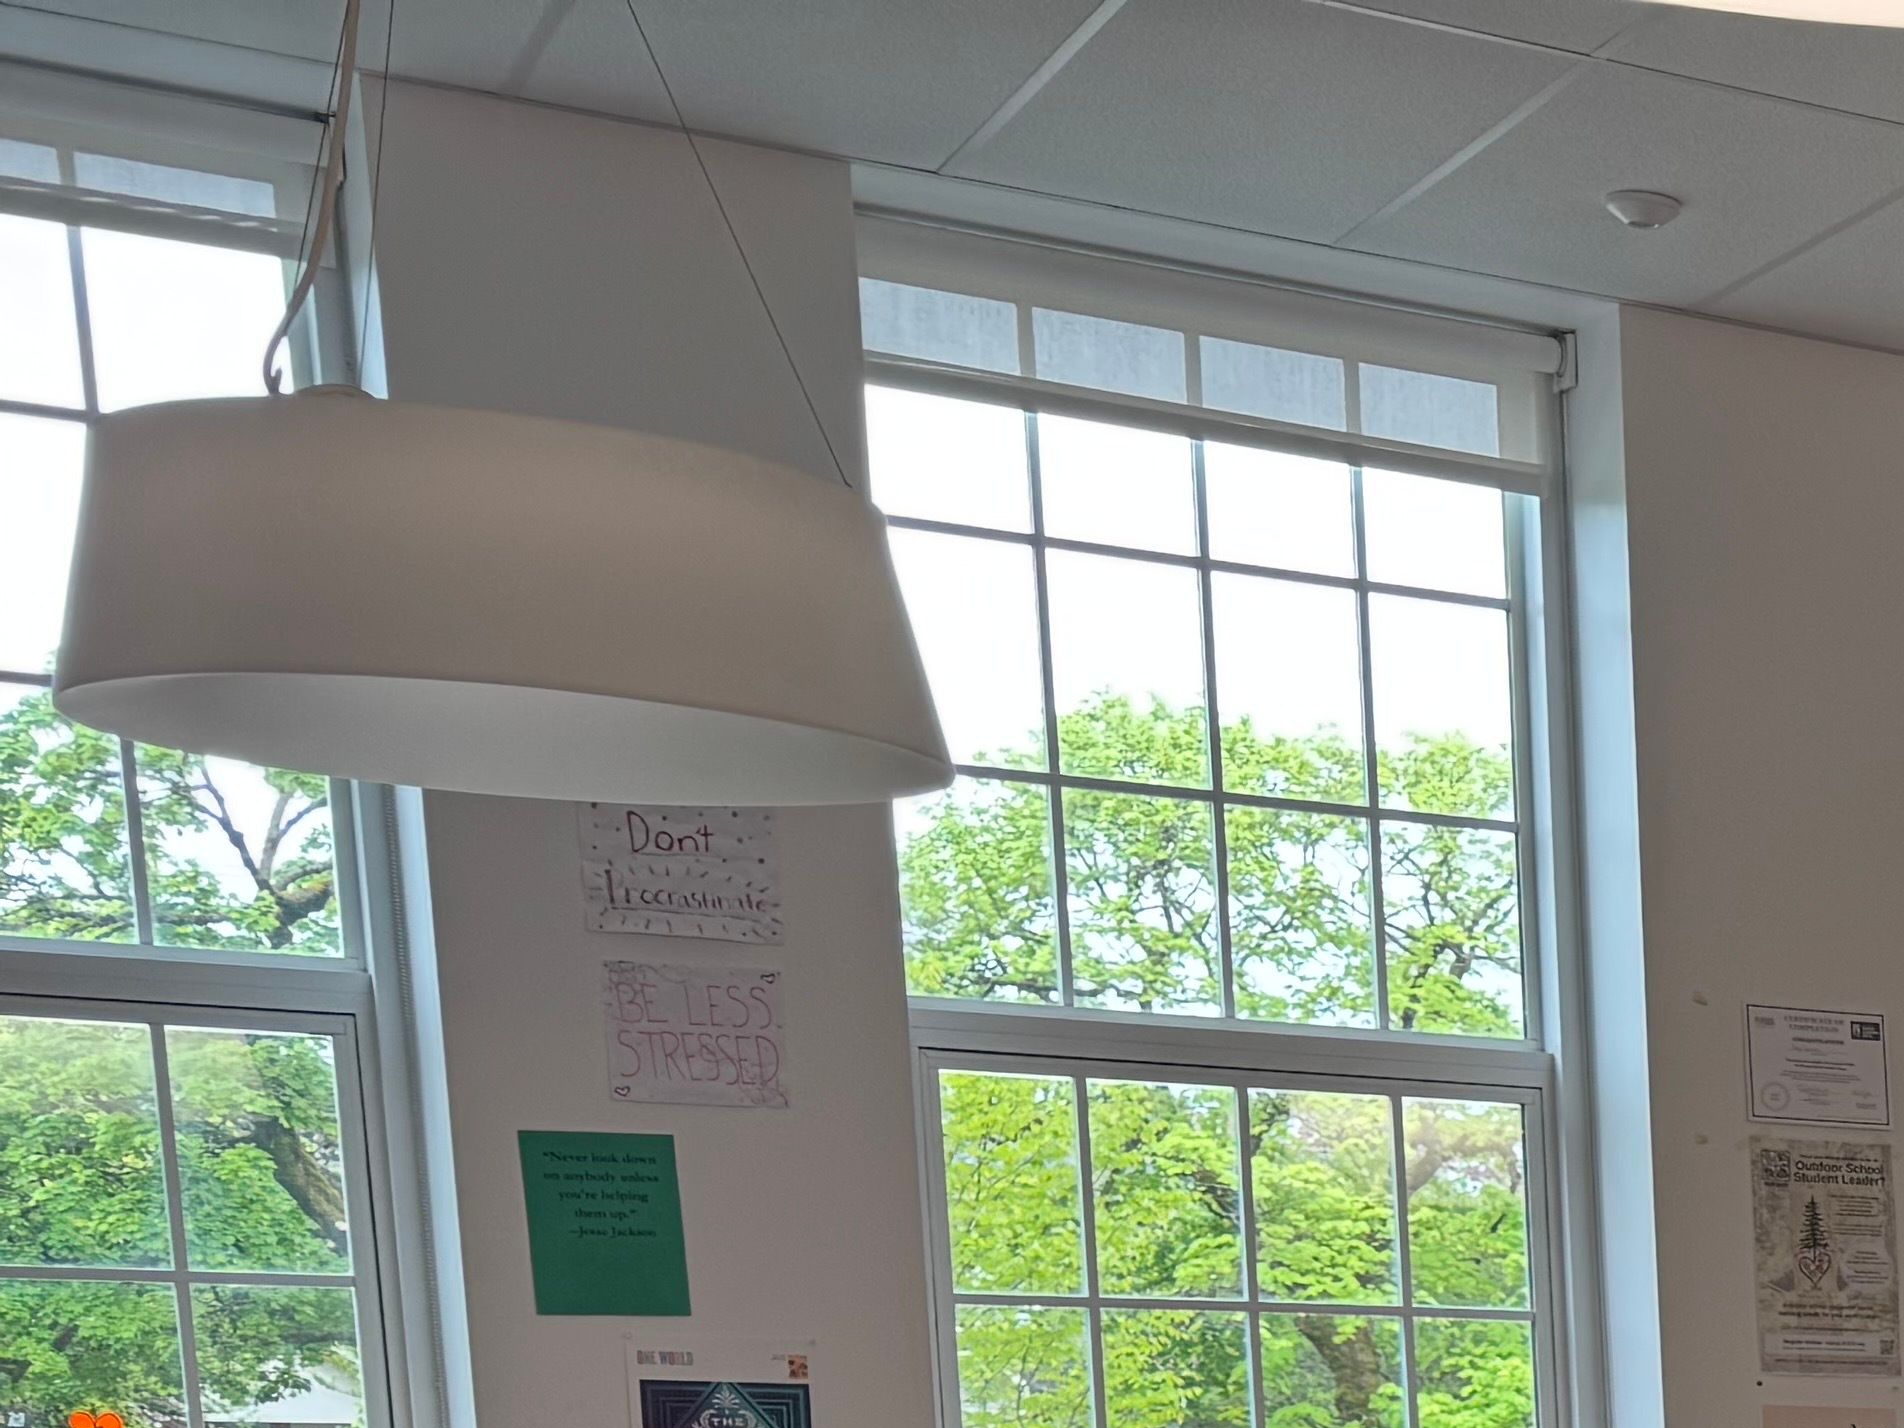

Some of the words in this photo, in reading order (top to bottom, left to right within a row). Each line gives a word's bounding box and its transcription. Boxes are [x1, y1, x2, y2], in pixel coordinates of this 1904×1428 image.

[616, 983, 668, 1023] BE
[684, 983, 771, 1029] LESS
[617, 1031, 780, 1085] STRESSED
